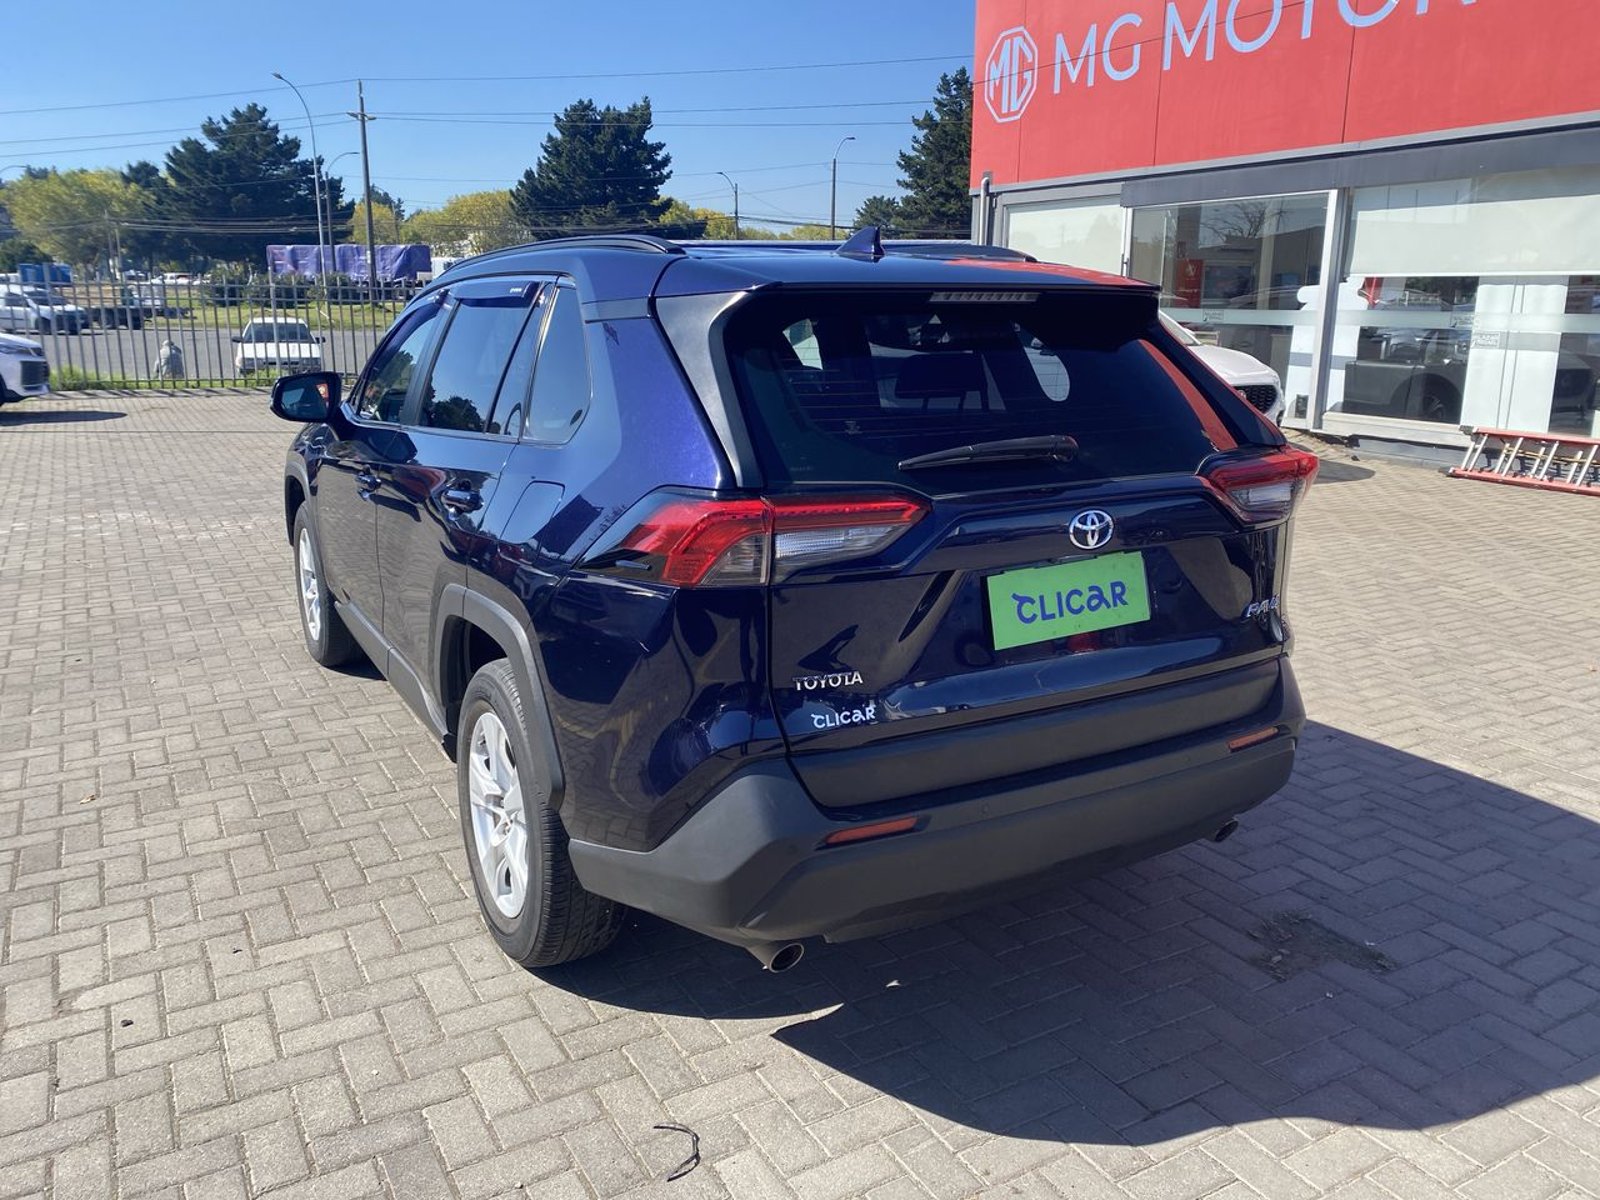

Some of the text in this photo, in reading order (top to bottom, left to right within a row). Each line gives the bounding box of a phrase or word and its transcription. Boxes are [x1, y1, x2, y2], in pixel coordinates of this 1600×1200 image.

[988, 36, 1034, 114] MG
[1053, 0, 1477, 95] MG MOT
[792, 670, 864, 691] TOYOTA
